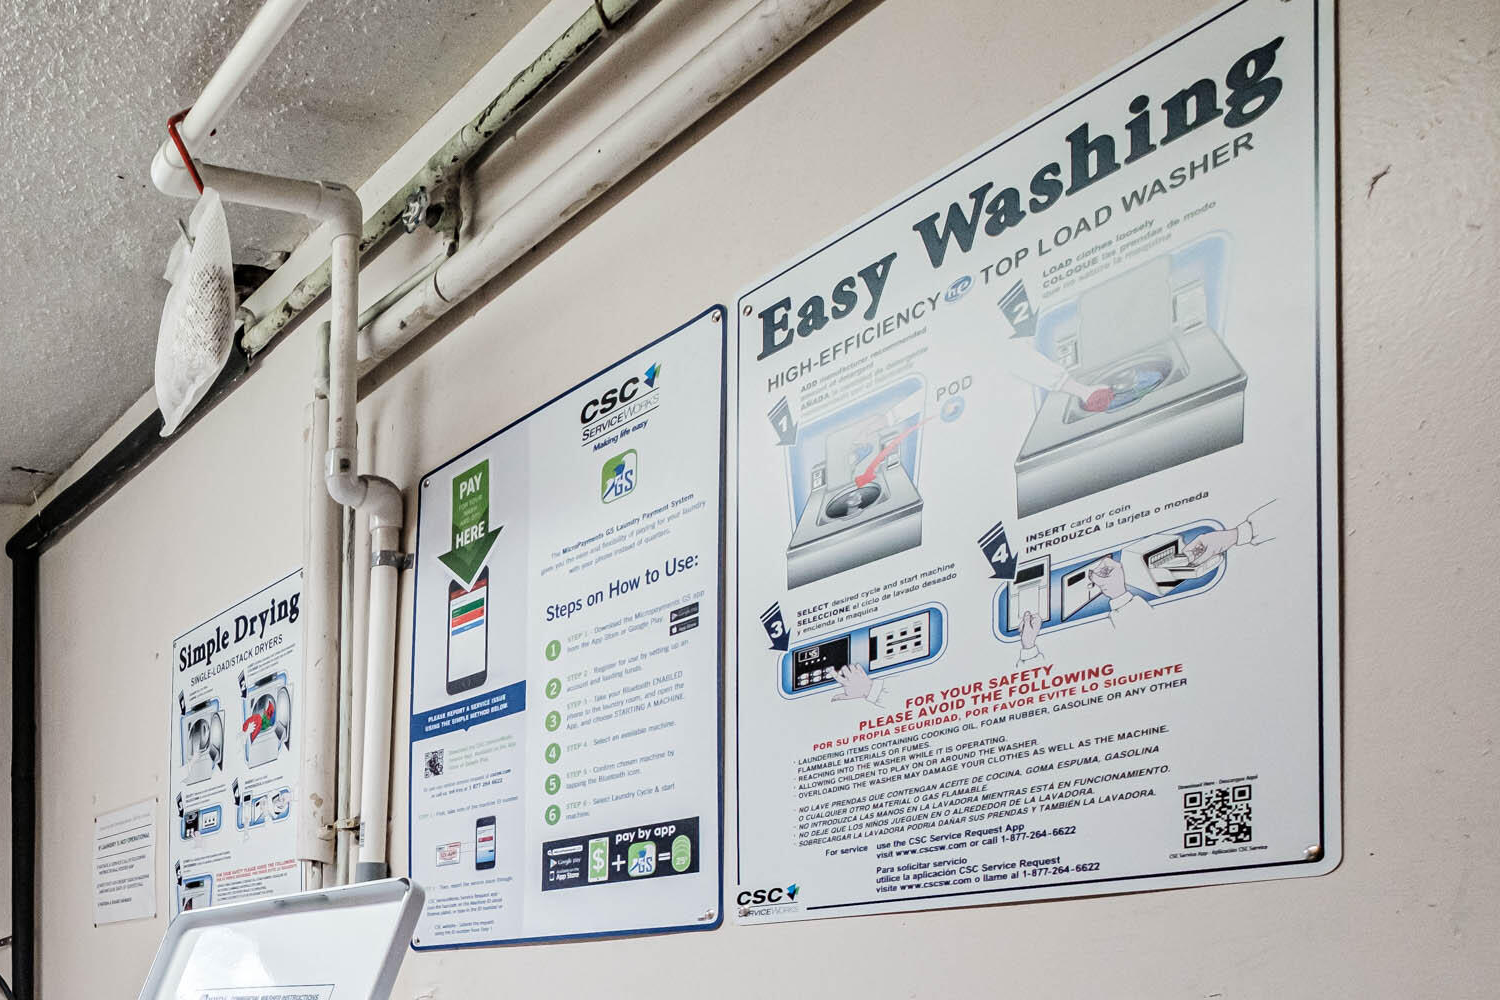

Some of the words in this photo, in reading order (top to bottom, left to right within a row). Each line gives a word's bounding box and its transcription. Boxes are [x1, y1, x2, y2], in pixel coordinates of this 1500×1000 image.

[757, 251, 897, 361] Easy
[913, 35, 1285, 271] Washing
[766, 295, 942, 393] HIGH-EFFICIENCY
[980, 246, 1029, 287] TOP
[1038, 205, 1113, 257] LOAD
[1121, 130, 1255, 213] WASHER
[1042, 258, 1072, 278] LOAD
[1012, 299, 1029, 322] 2
[581, 376, 640, 424] CSC
[935, 374, 973, 402] POD
[592, 435, 618, 453] Making
[620, 427, 631, 439] life
[632, 419, 648, 432] easy
[459, 472, 482, 500] PAY
[615, 468, 633, 496] GS
[455, 520, 485, 549] HERE
[1025, 524, 1100, 554] INTRODUZCA
[1105, 519, 1114, 529] la
[1117, 508, 1150, 527] tarjeta
[1154, 506, 1160, 514] o
[1164, 490, 1208, 511] moneda
[1025, 523, 1066, 543] INSERT
[1070, 515, 1092, 529] card
[1094, 512, 1105, 521] or
[1108, 505, 1130, 517] coin
[991, 543, 1009, 564] 4
[546, 598, 582, 622] Steps
[587, 591, 604, 606] on
[609, 575, 640, 599] How
[645, 569, 659, 585] to
[665, 555, 699, 576] Use:
[797, 602, 828, 617] SELECT
[831, 593, 858, 607] desired
[860, 586, 880, 599] cycle
[882, 580, 897, 591] and
[899, 574, 917, 585] start
[919, 562, 955, 579] machine
[797, 605, 850, 627] SELECCIONE
[852, 602, 859, 610] el
[861, 596, 879, 607] ciclo
[881, 592, 891, 601] de
[893, 583, 919, 597] lavado
[921, 572, 957, 588] deseado
[179, 625, 229, 672] Simple
[234, 592, 300, 643] Drying
[770, 620, 784, 639] 3
[802, 618, 835, 634] encienda
[845, 607, 878, 622] maquina
[255, 634, 283, 656] DRYERS
[550, 644, 556, 657] 1
[549, 681, 557, 696] 2
[859, 710, 912, 732] PLEASE
[917, 698, 965, 718] AVOID
[970, 689, 1002, 706] THE
[1008, 663, 1114, 697] FOLLOWING
[905, 692, 934, 709] FOR
[940, 680, 982, 701] YOUR
[988, 664, 1053, 689] SAFETY
[549, 714, 557, 728] 3
[798, 750, 844, 766] LAUNDERING
[846, 744, 869, 756] ITEMS
[870, 734, 918, 750] CONTAINING
[921, 725, 959, 740] COOKING
[980, 716, 1006, 727] FOAM
[1052, 695, 1103, 712] GASOLINE
[1106, 691, 1121, 701] OR
[1124, 686, 1146, 697] ANY
[1149, 677, 1187, 692] OTHER
[813, 740, 832, 752] POR
[836, 736, 849, 746] SU
[852, 727, 890, 743] PROPIA
[894, 712, 960, 734] SEGURIDAD,
[965, 706, 988, 718] POR
[992, 696, 1034, 712] FAVOR
[1038, 687, 1076, 702] EVITE
[1081, 682, 1098, 693] LO
[1103, 664, 1182, 688] SIGUIENTE
[548, 747, 557, 760] 4
[549, 777, 556, 790] 5
[549, 808, 556, 822] 6
[615, 831, 636, 845] pay
[637, 828, 653, 840] by
[654, 824, 676, 838] app
[876, 842, 891, 851] use
[893, 839, 906, 848] the
[908, 836, 926, 846] CSC
[929, 831, 961, 842] Service
[964, 826, 1002, 839] Request
[1004, 823, 1024, 834] App
[876, 851, 893, 861] visit
[895, 842, 966, 858] www.cscsw.com
[981, 836, 998, 846] call
[1001, 826, 1076, 843] 1-877-264-6622
[638, 856, 652, 873] GS
[825, 848, 838, 856] For
[840, 846, 868, 855] service
[556, 873, 566, 881] App
[567, 871, 580, 879] Store
[875, 874, 900, 884] utilice
[902, 873, 910, 881] la
[912, 868, 956, 882] aplicación
[958, 865, 978, 875] CSC
[981, 861, 1016, 872] Service
[1019, 857, 1060, 870] Request
[875, 884, 897, 894] visite
[899, 878, 971, 891] www.cscsw.com
[982, 872, 1007, 882] llame
[1010, 871, 1019, 879] al
[1022, 862, 1100, 878] 1-877-264-6622
[876, 865, 894, 874] Para
[896, 861, 930, 872] solicitar
[932, 858, 967, 868] servicio
[737, 887, 783, 906] CSC
